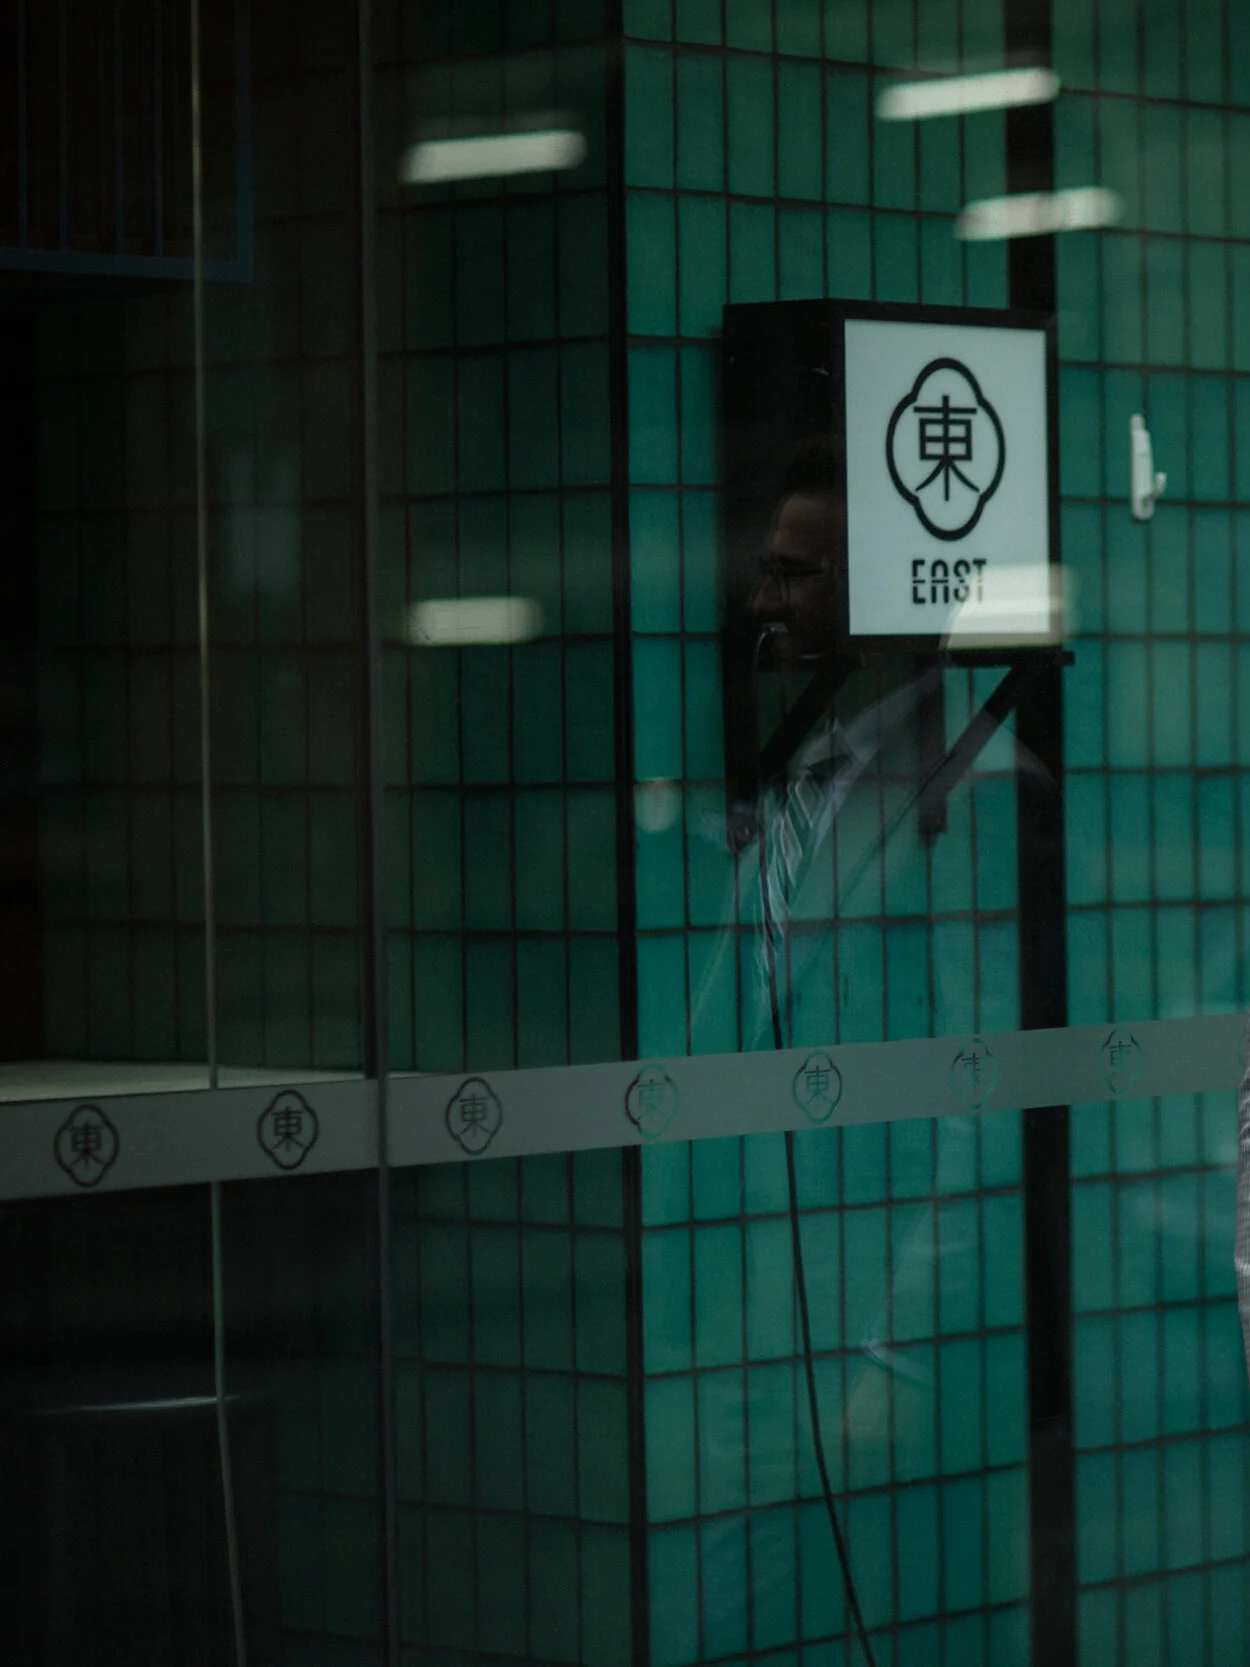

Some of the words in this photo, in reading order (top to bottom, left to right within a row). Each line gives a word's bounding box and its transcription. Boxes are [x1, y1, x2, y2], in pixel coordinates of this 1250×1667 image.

[914, 396, 979, 501] 東
[911, 558, 987, 605] EAST
[271, 1105, 304, 1153] 東
[460, 1093, 490, 1137] 東
[70, 1121, 103, 1169] 東
